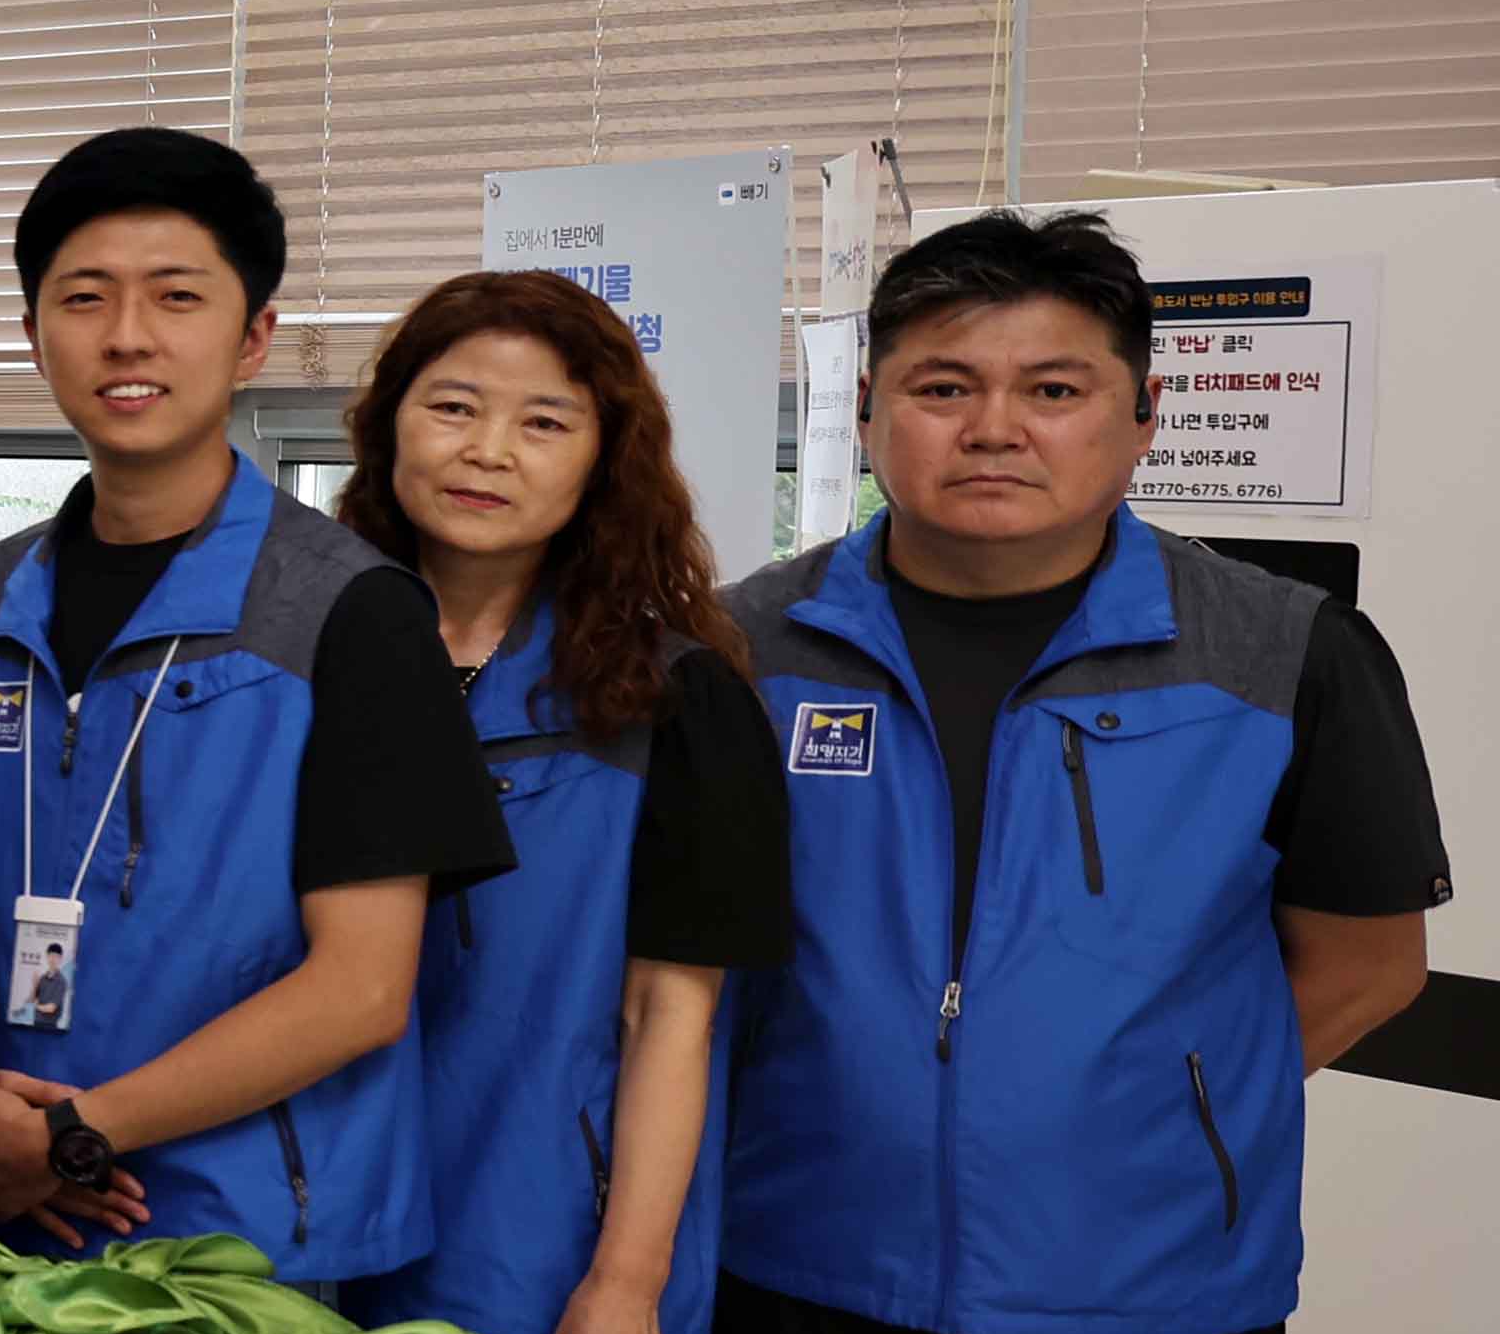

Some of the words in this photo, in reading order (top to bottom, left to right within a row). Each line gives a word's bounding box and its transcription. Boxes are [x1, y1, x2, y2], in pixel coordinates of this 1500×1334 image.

[740, 183, 769, 201] 빼기
[505, 228, 548, 252] 집에서
[551, 223, 604, 249] 1분만에
[628, 313, 662, 353] 청
[1221, 334, 1253, 353] 클릭
[1194, 372, 1281, 393] 터치패드에
[1286, 371, 1320, 392] 인식
[1171, 413, 1202, 431] 나면
[1206, 413, 1269, 431] 투입구에
[1180, 450, 1257, 468] 넣어주세요
[1237, 483, 1283, 499] 6776)
